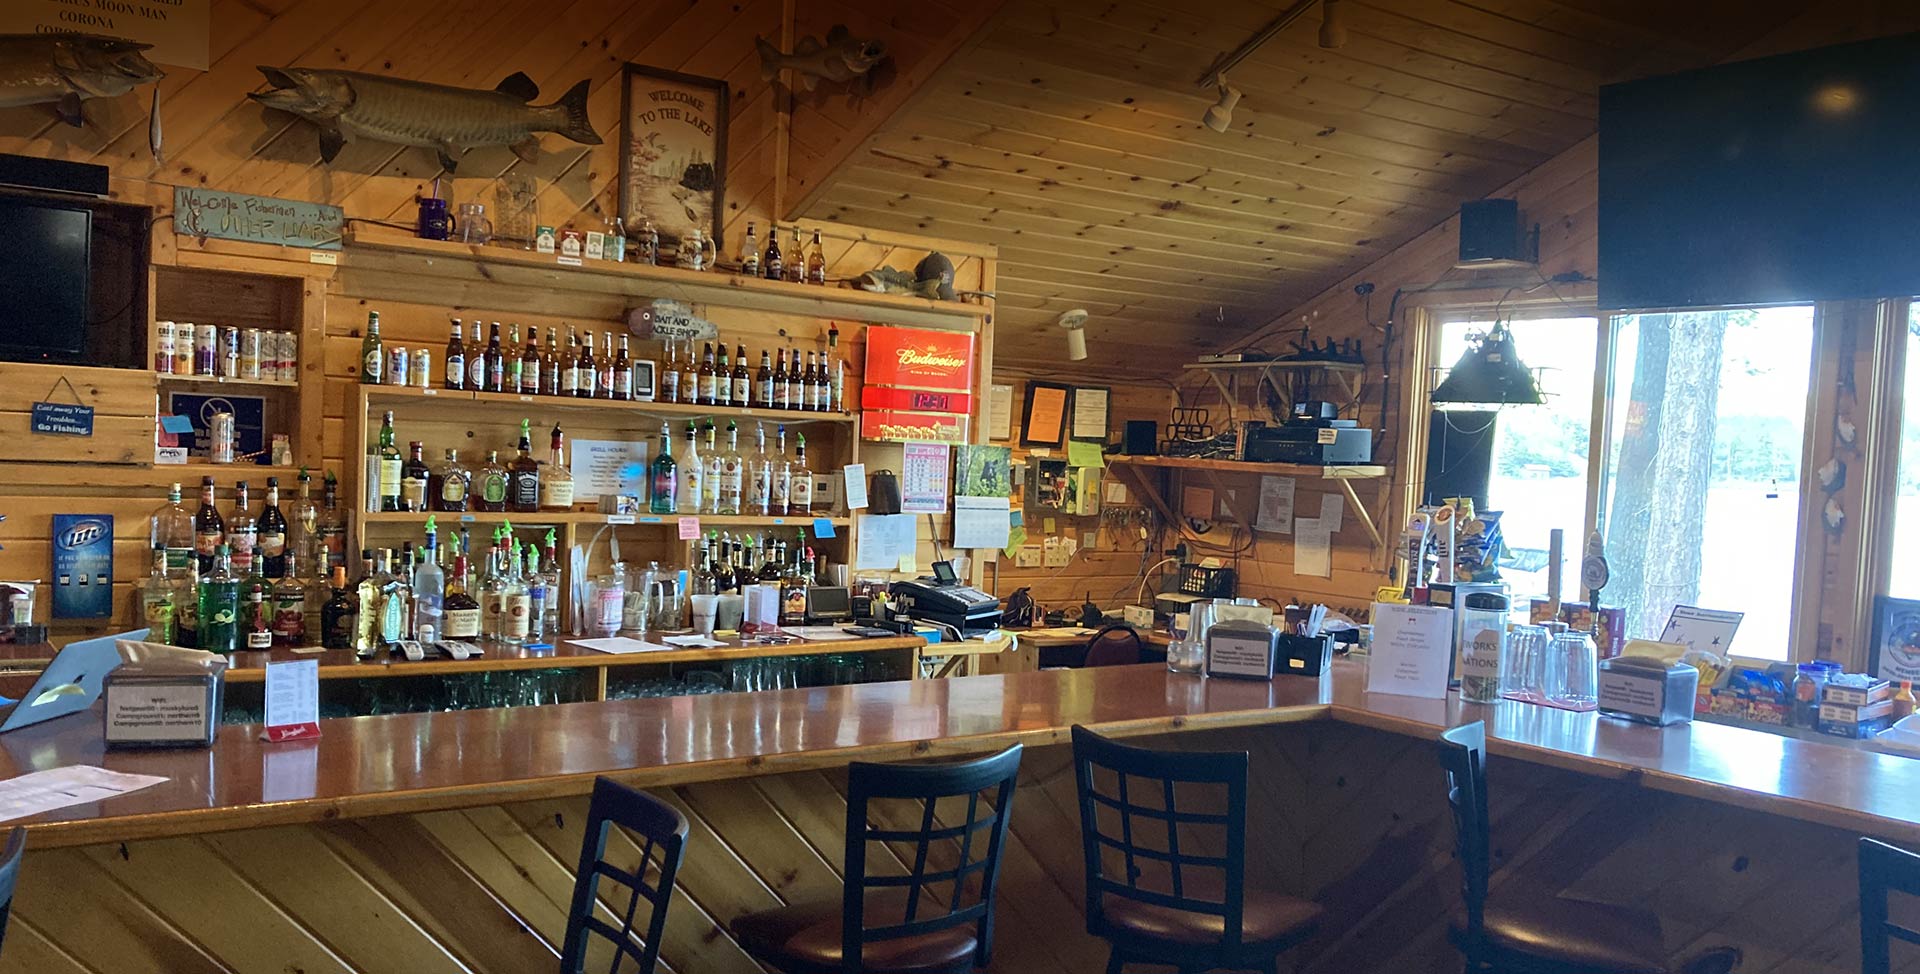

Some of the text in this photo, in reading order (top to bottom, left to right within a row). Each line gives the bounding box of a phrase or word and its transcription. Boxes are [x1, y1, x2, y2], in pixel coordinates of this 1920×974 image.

[58, 10, 114, 29] CORONA
[94, 0, 134, 15] MOON
[139, 6, 167, 21] MAN
[648, 90, 704, 112] WELCOME
[639, 108, 714, 136] TO THE LAKE
[220, 215, 274, 238] OTHER
[655, 314, 690, 327] BAIT AND
[652, 324, 700, 338] ACKLE SHOP
[896, 349, 967, 367] Budweiser
[37, 423, 51, 431] Go
